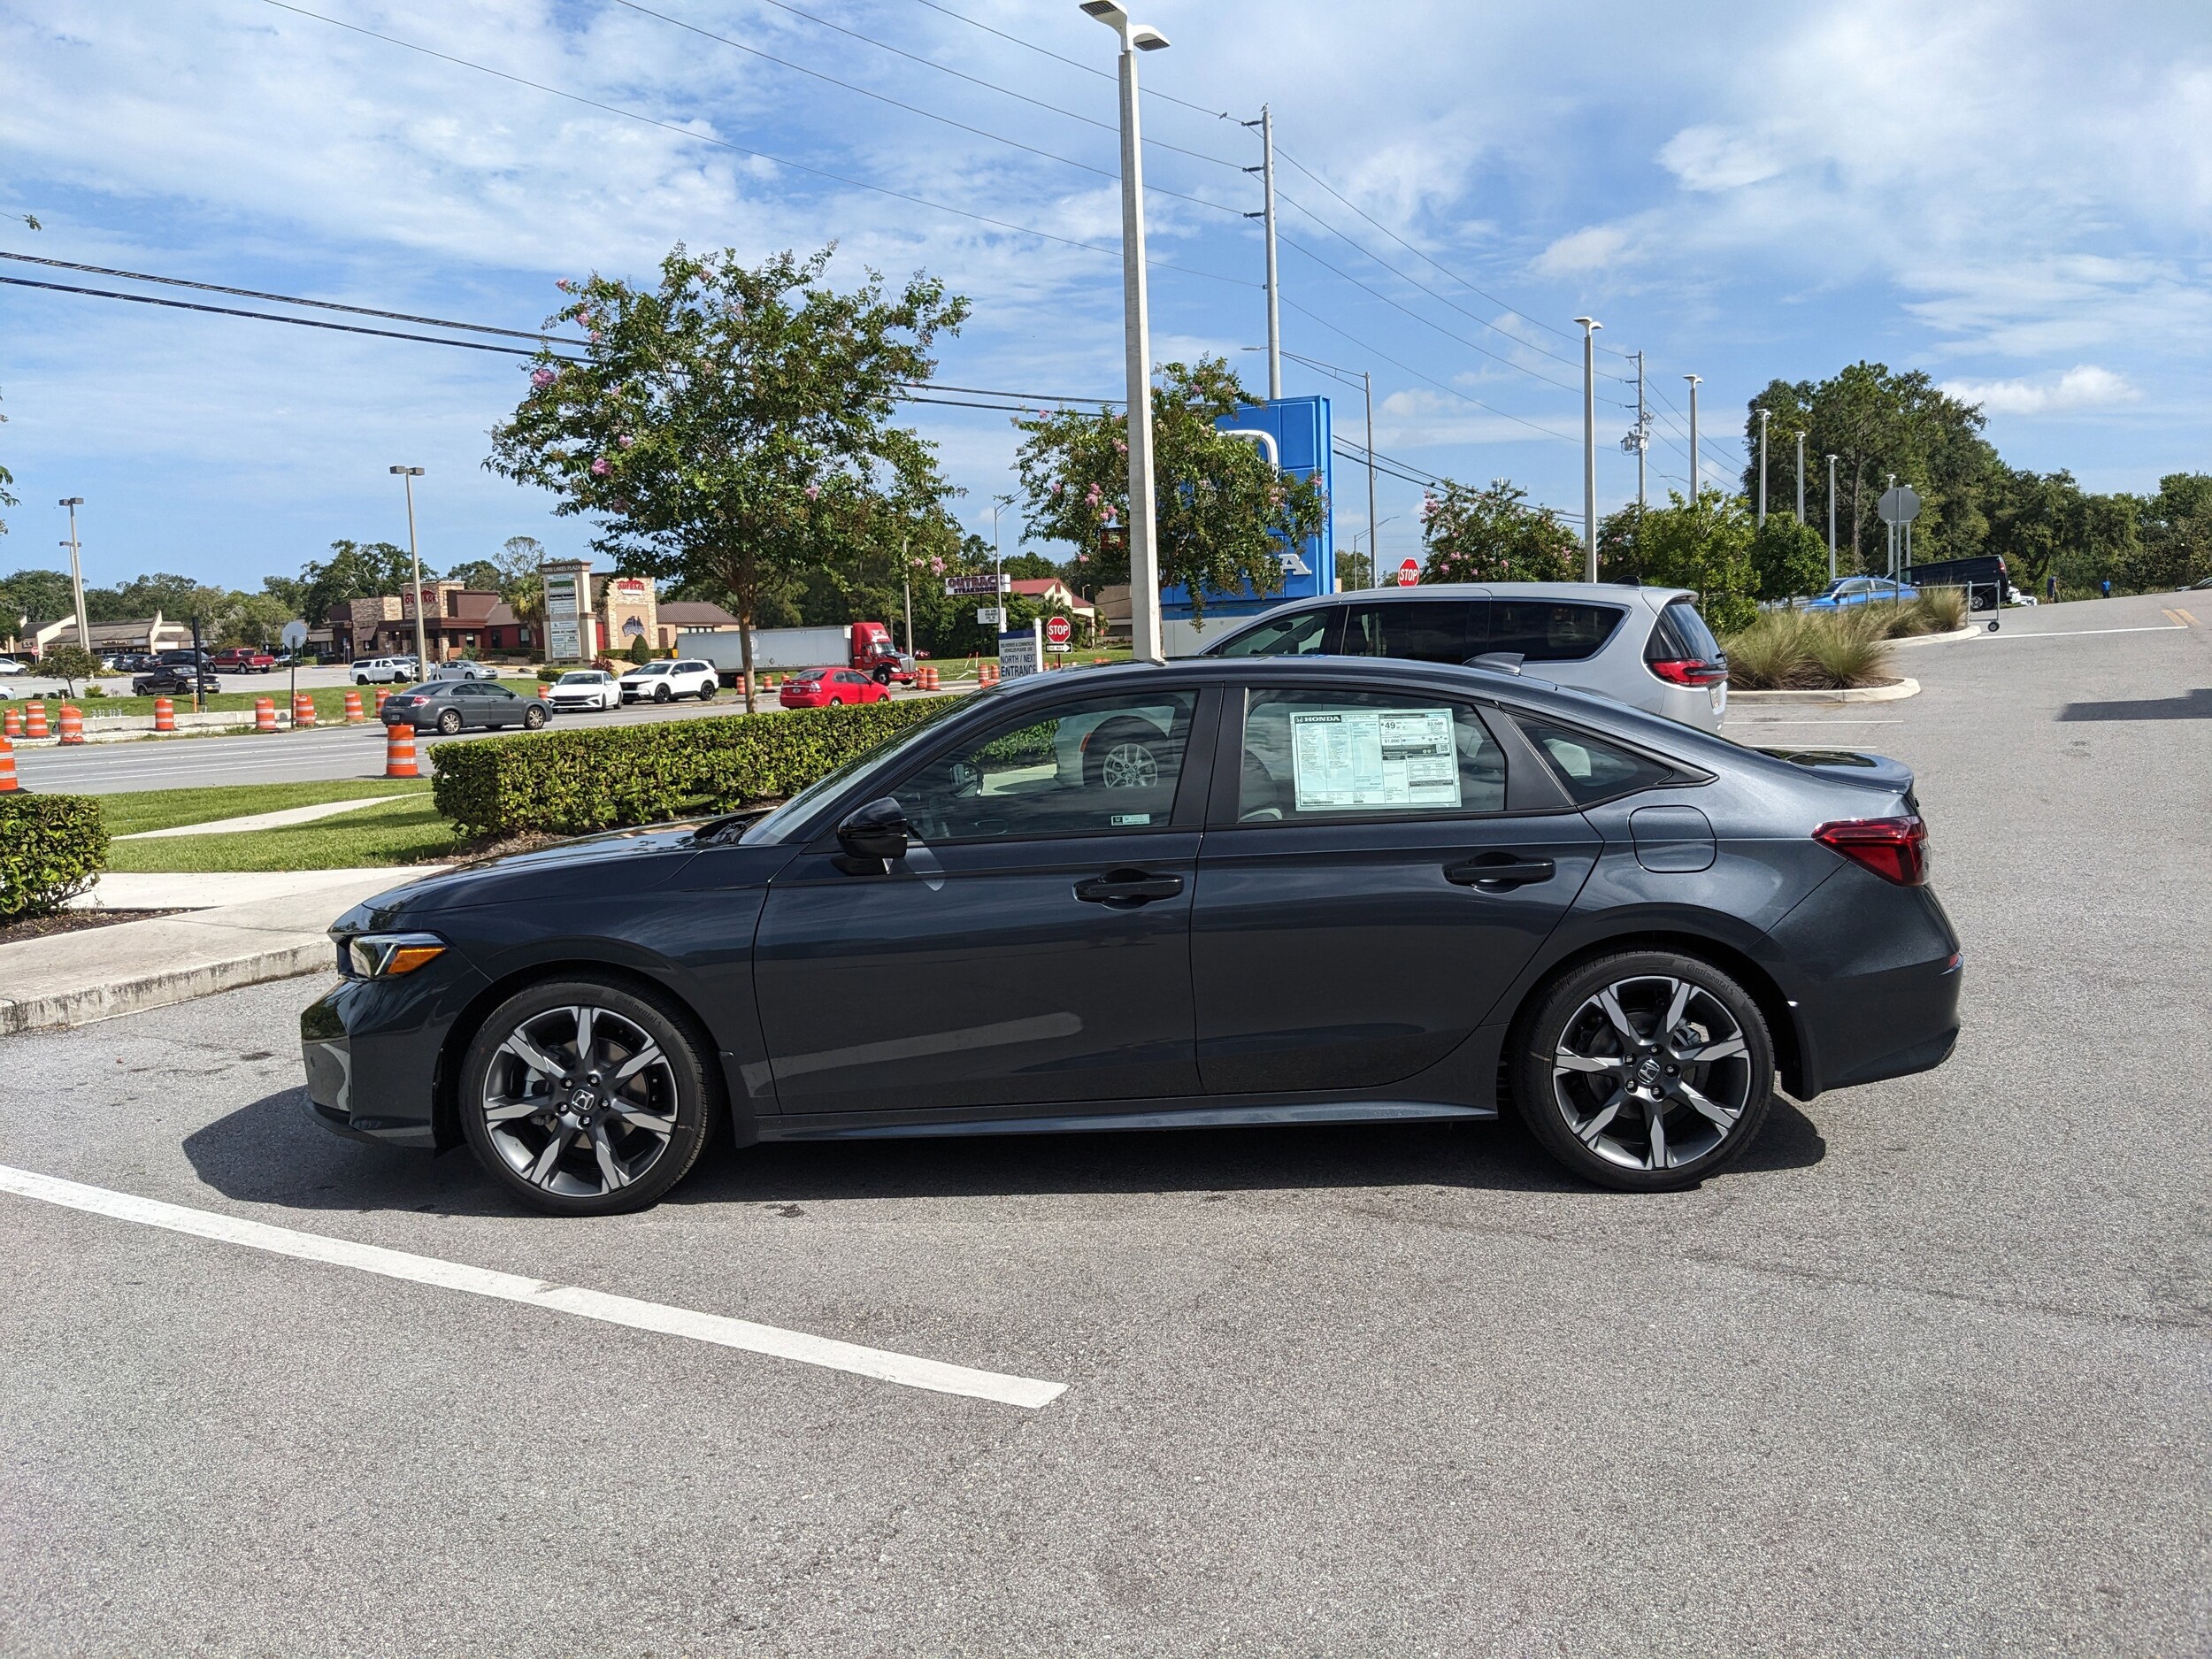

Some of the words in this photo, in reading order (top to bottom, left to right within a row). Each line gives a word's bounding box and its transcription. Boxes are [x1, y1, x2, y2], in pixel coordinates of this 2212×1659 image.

[1400, 568, 1418, 581] STOP
[617, 581, 645, 591] OUTBACK
[1048, 625, 1068, 635] STOP
[1024, 654, 1036, 663] NEXT
[1001, 664, 1037, 677] ENTRANCE
[1687, 964, 1730, 990] Continental
